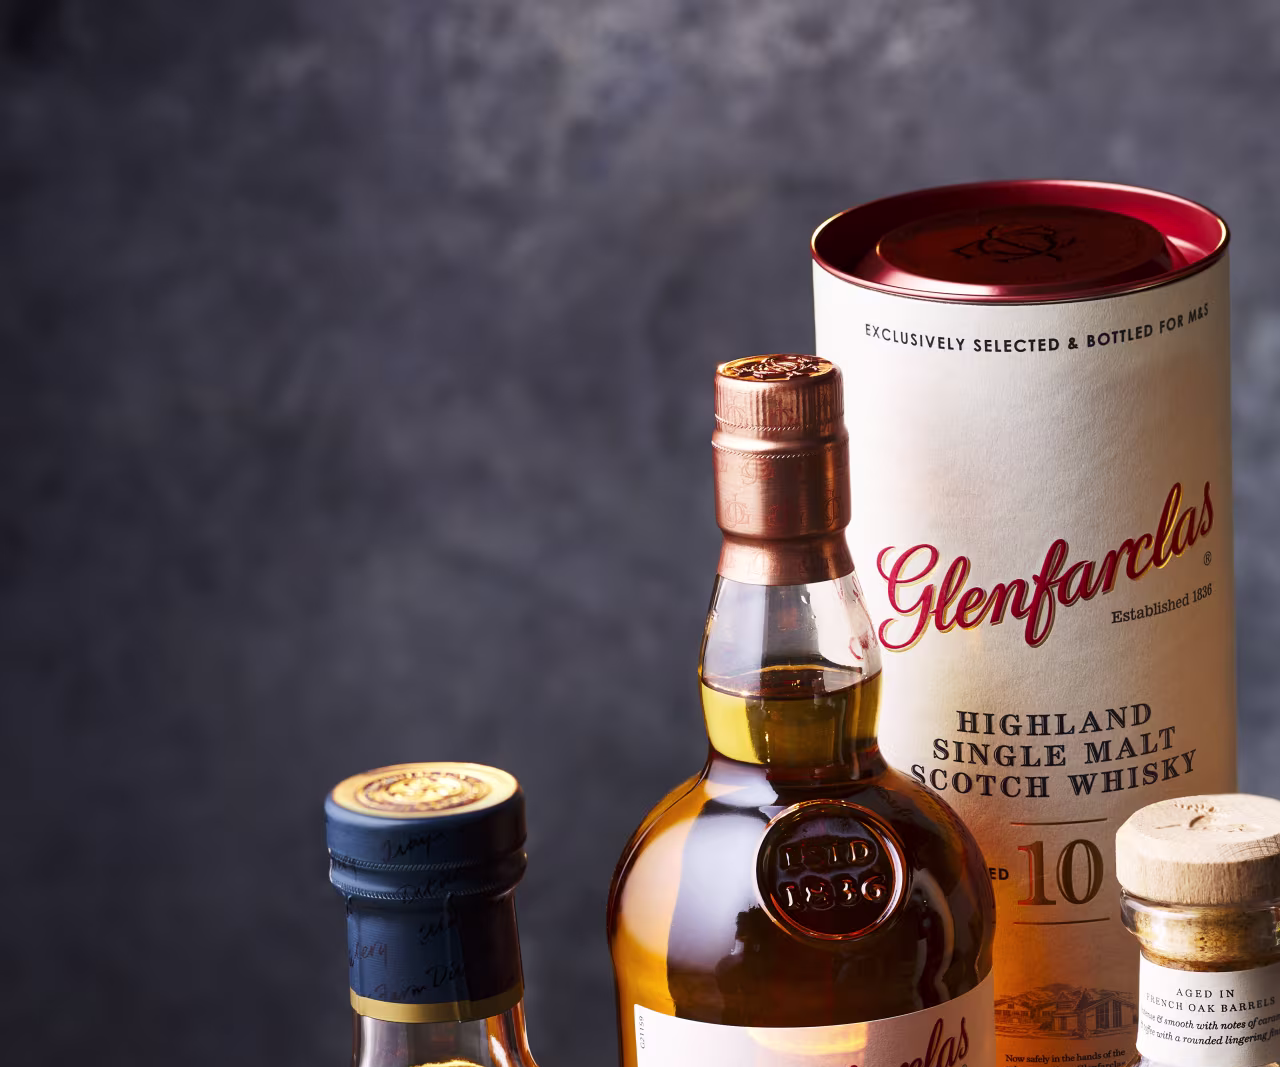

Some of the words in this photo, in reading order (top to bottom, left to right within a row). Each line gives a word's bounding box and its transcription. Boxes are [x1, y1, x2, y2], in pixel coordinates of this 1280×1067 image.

[865, 323, 965, 351] EXCLUSIVELY
[973, 338, 1059, 352] SELECTED
[1068, 337, 1079, 350] &
[1086, 323, 1153, 348] BOTTLED
[1159, 315, 1184, 335] FOR
[1188, 303, 1209, 325] M&S
[877, 481, 1214, 653] Glenfarclas
[1111, 596, 1190, 624] Established
[1192, 583, 1213, 602] 1836
[957, 703, 1152, 736] HIGHLAND
[933, 738, 1067, 767] SINGLE
[1085, 726, 1176, 764] MALT
[911, 764, 1050, 798] SCOTCH
[1068, 749, 1197, 796] WHISKY
[1017, 839, 1104, 905] 10
[1146, 993, 1183, 1010] FRENCH
[1189, 1004, 1215, 1012] OAK
[1221, 997, 1275, 1012] BARRELS
[1176, 988, 1212, 998] AGED
[1220, 990, 1235, 998] IN
[1026, 1054, 1049, 1064] safely
[1062, 1054, 1075, 1062] the
[1076, 1050, 1101, 1061] hands
[1103, 1050, 1111, 1058] of
